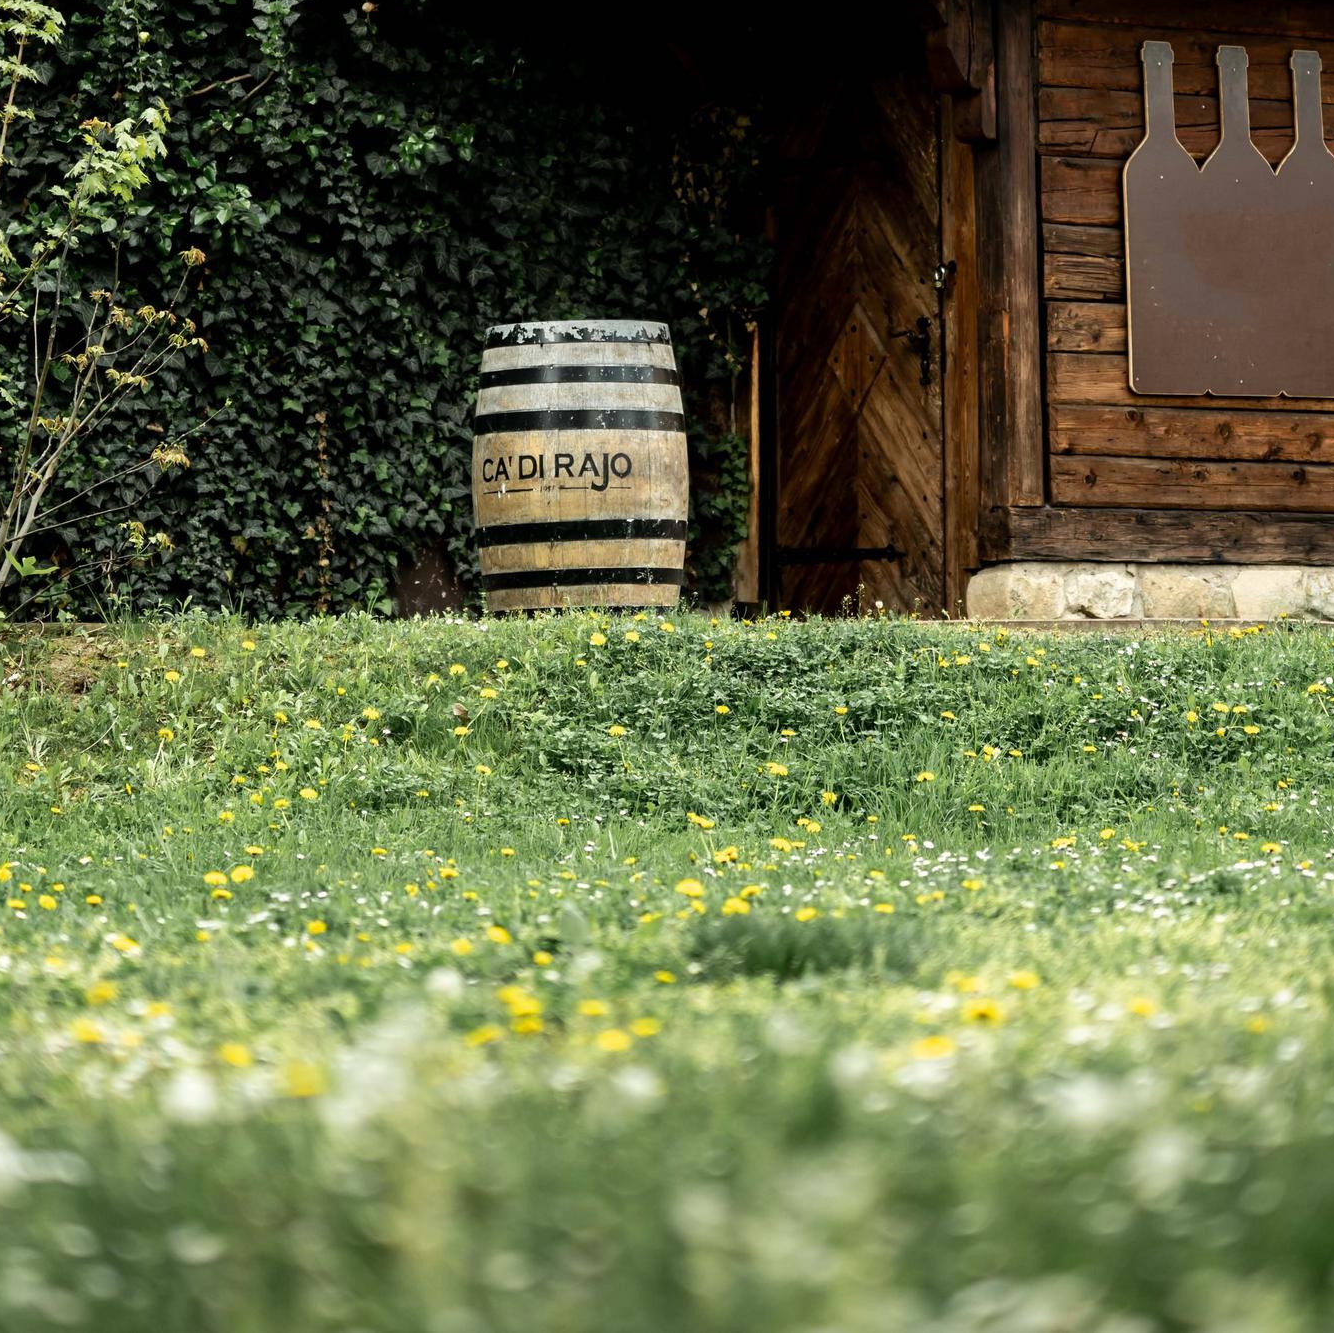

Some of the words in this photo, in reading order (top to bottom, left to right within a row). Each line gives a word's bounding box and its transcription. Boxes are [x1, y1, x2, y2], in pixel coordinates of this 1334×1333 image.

[482, 456, 513, 483] CA'
[518, 454, 544, 480] DI
[554, 452, 632, 492] RAJO
